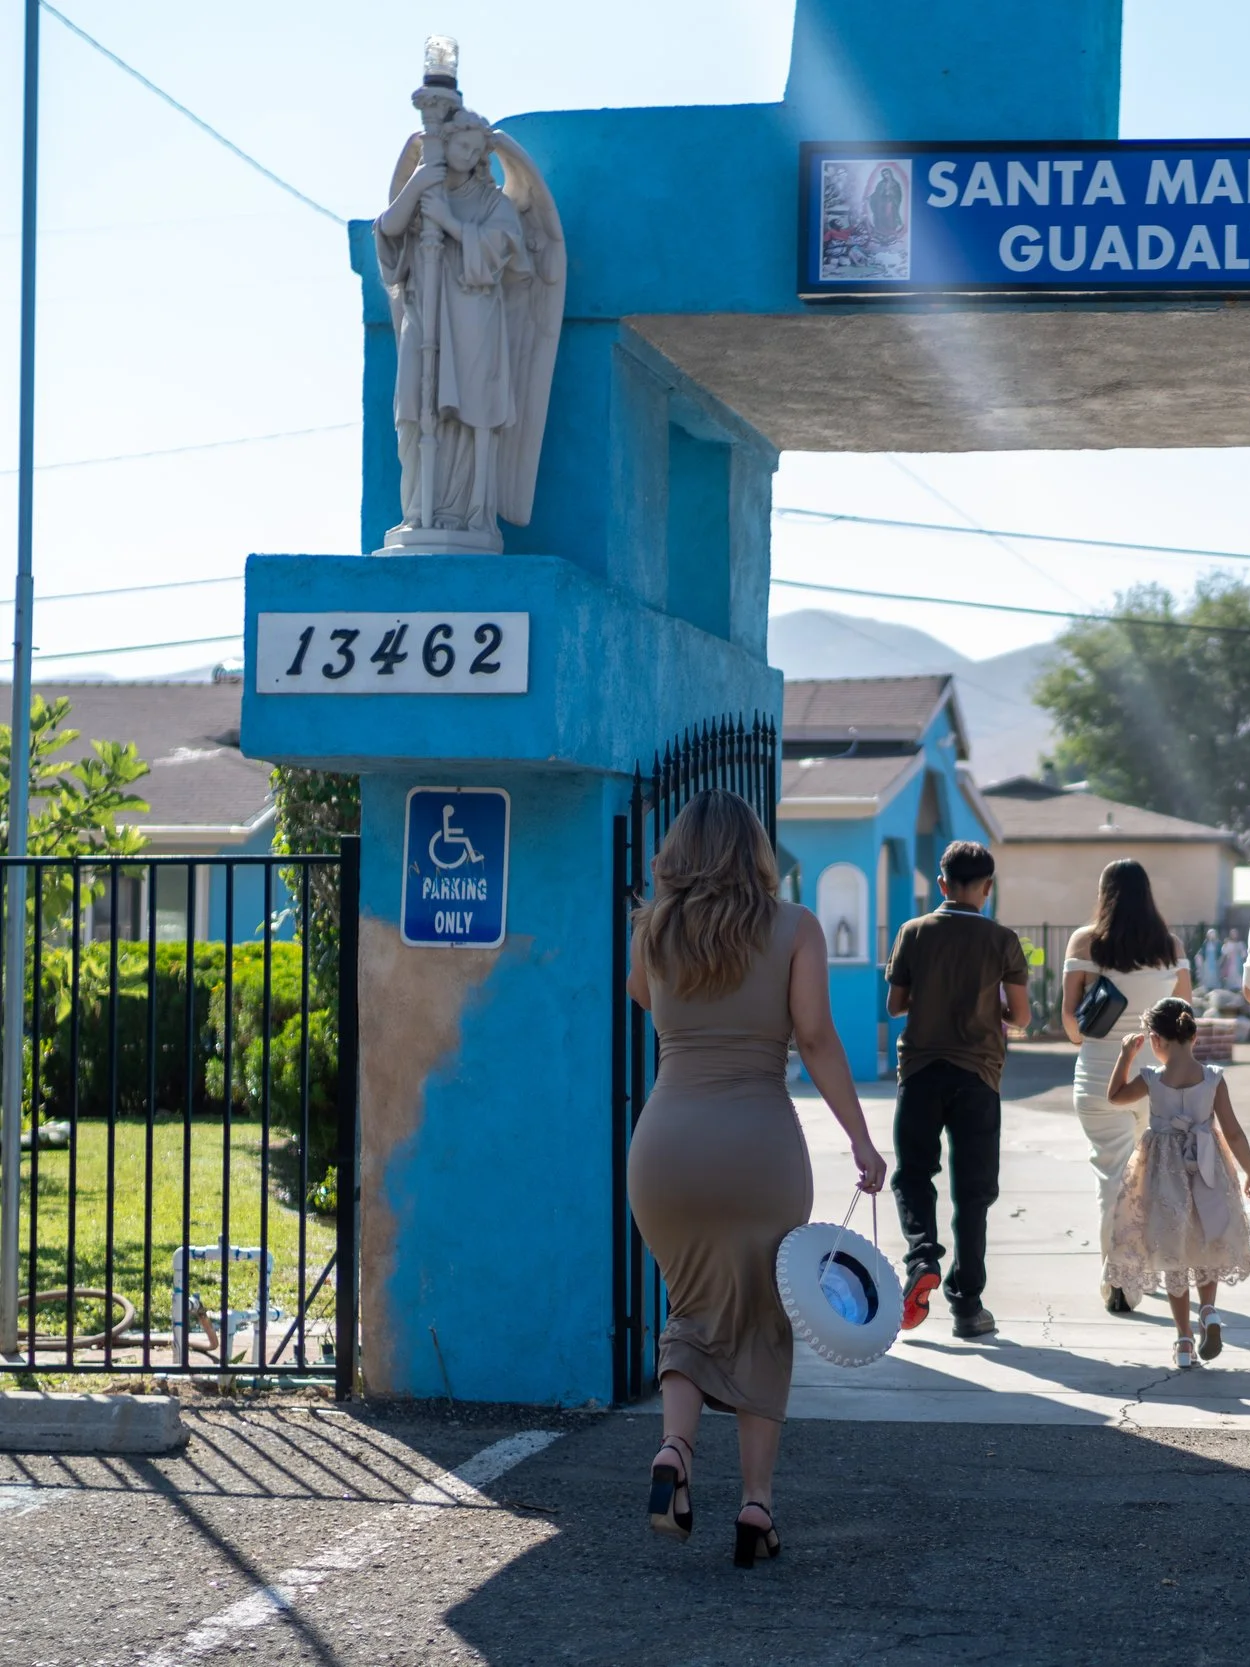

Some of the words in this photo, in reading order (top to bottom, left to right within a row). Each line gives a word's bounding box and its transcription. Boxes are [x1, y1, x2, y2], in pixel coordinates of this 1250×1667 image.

[926, 160, 1126, 208] SANTA
[286, 622, 504, 680] 13462
[422, 876, 488, 901] PARKING
[434, 910, 474, 934] ONLY
